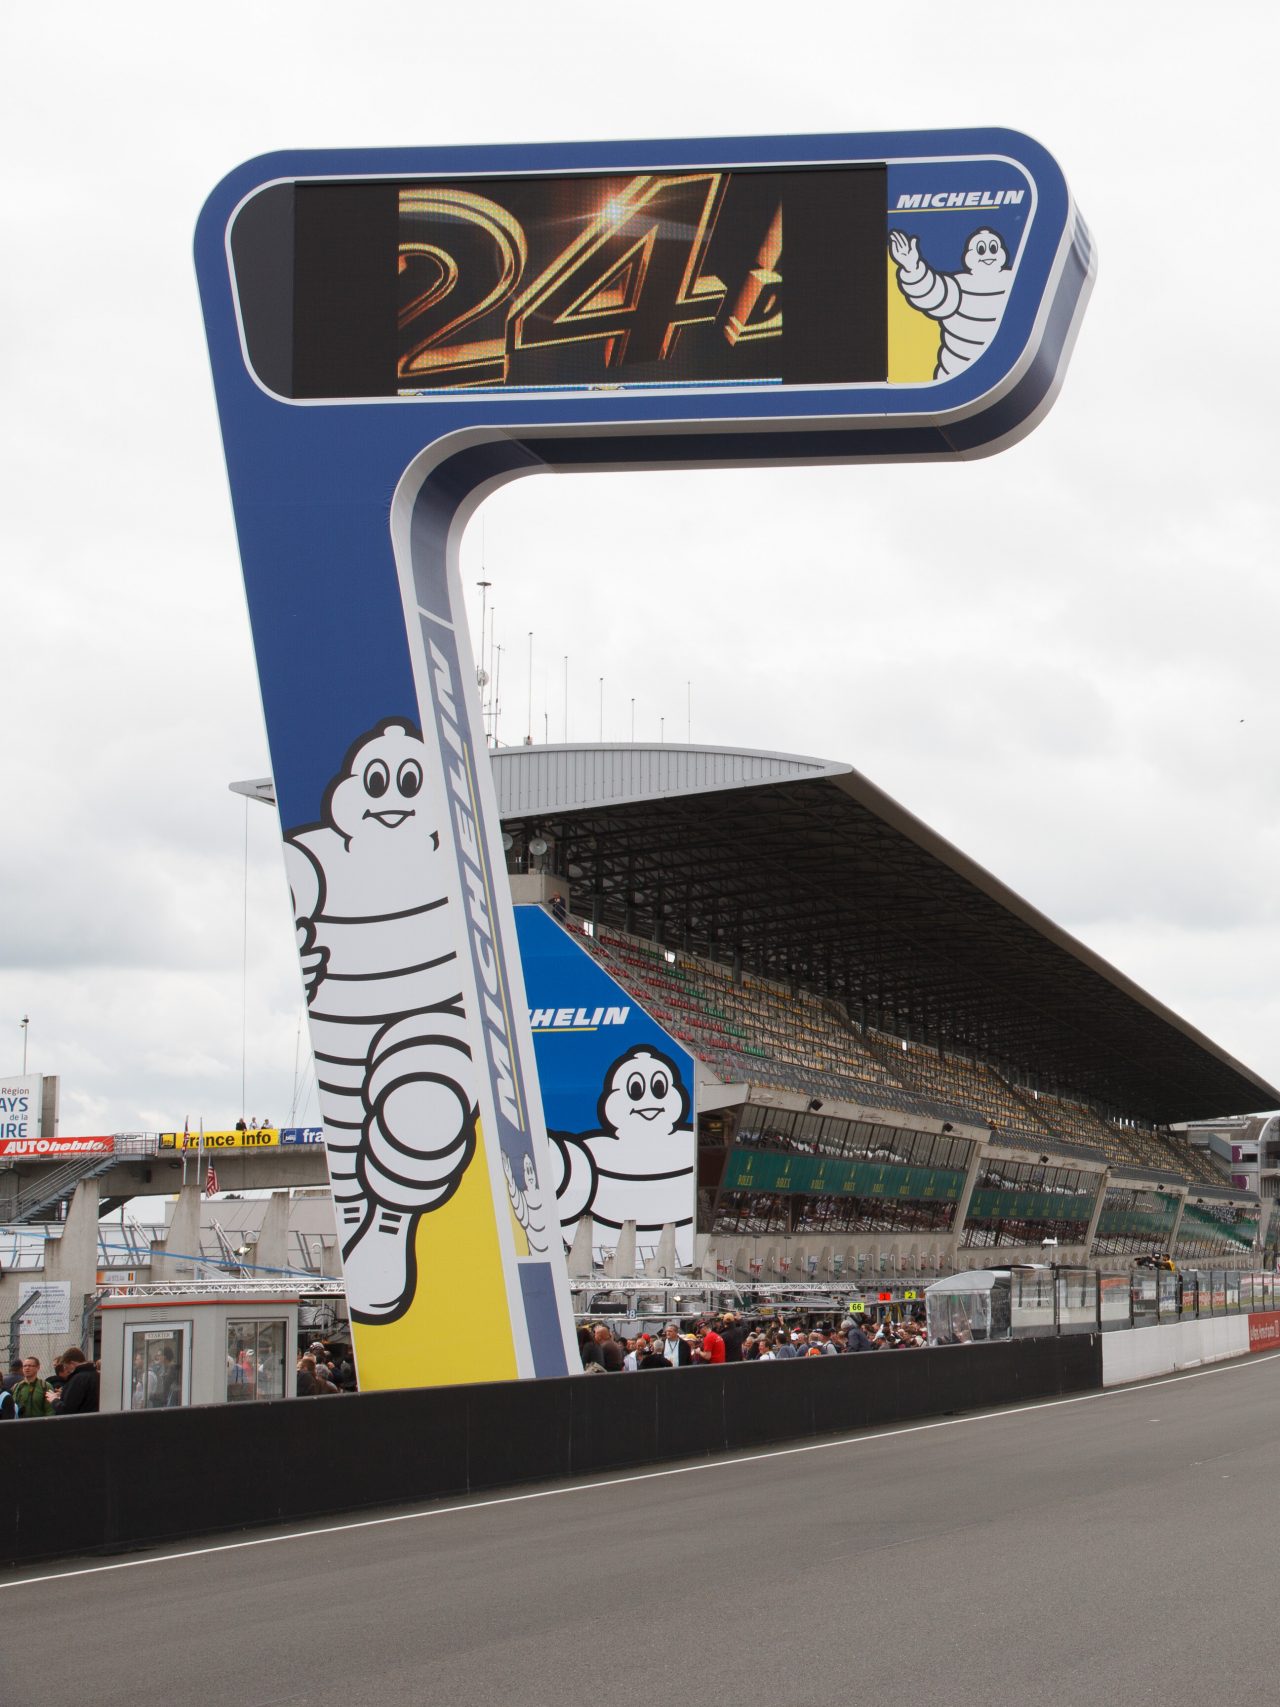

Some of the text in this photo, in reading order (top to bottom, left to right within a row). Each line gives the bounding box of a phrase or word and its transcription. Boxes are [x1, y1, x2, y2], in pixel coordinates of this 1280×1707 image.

[896, 190, 1025, 209] MICHELIN
[428, 637, 522, 1131] MICHELIN
[1, 1087, 30, 1097] Région
[21, 1113, 29, 1121] la
[241, 1131, 272, 1145] info
